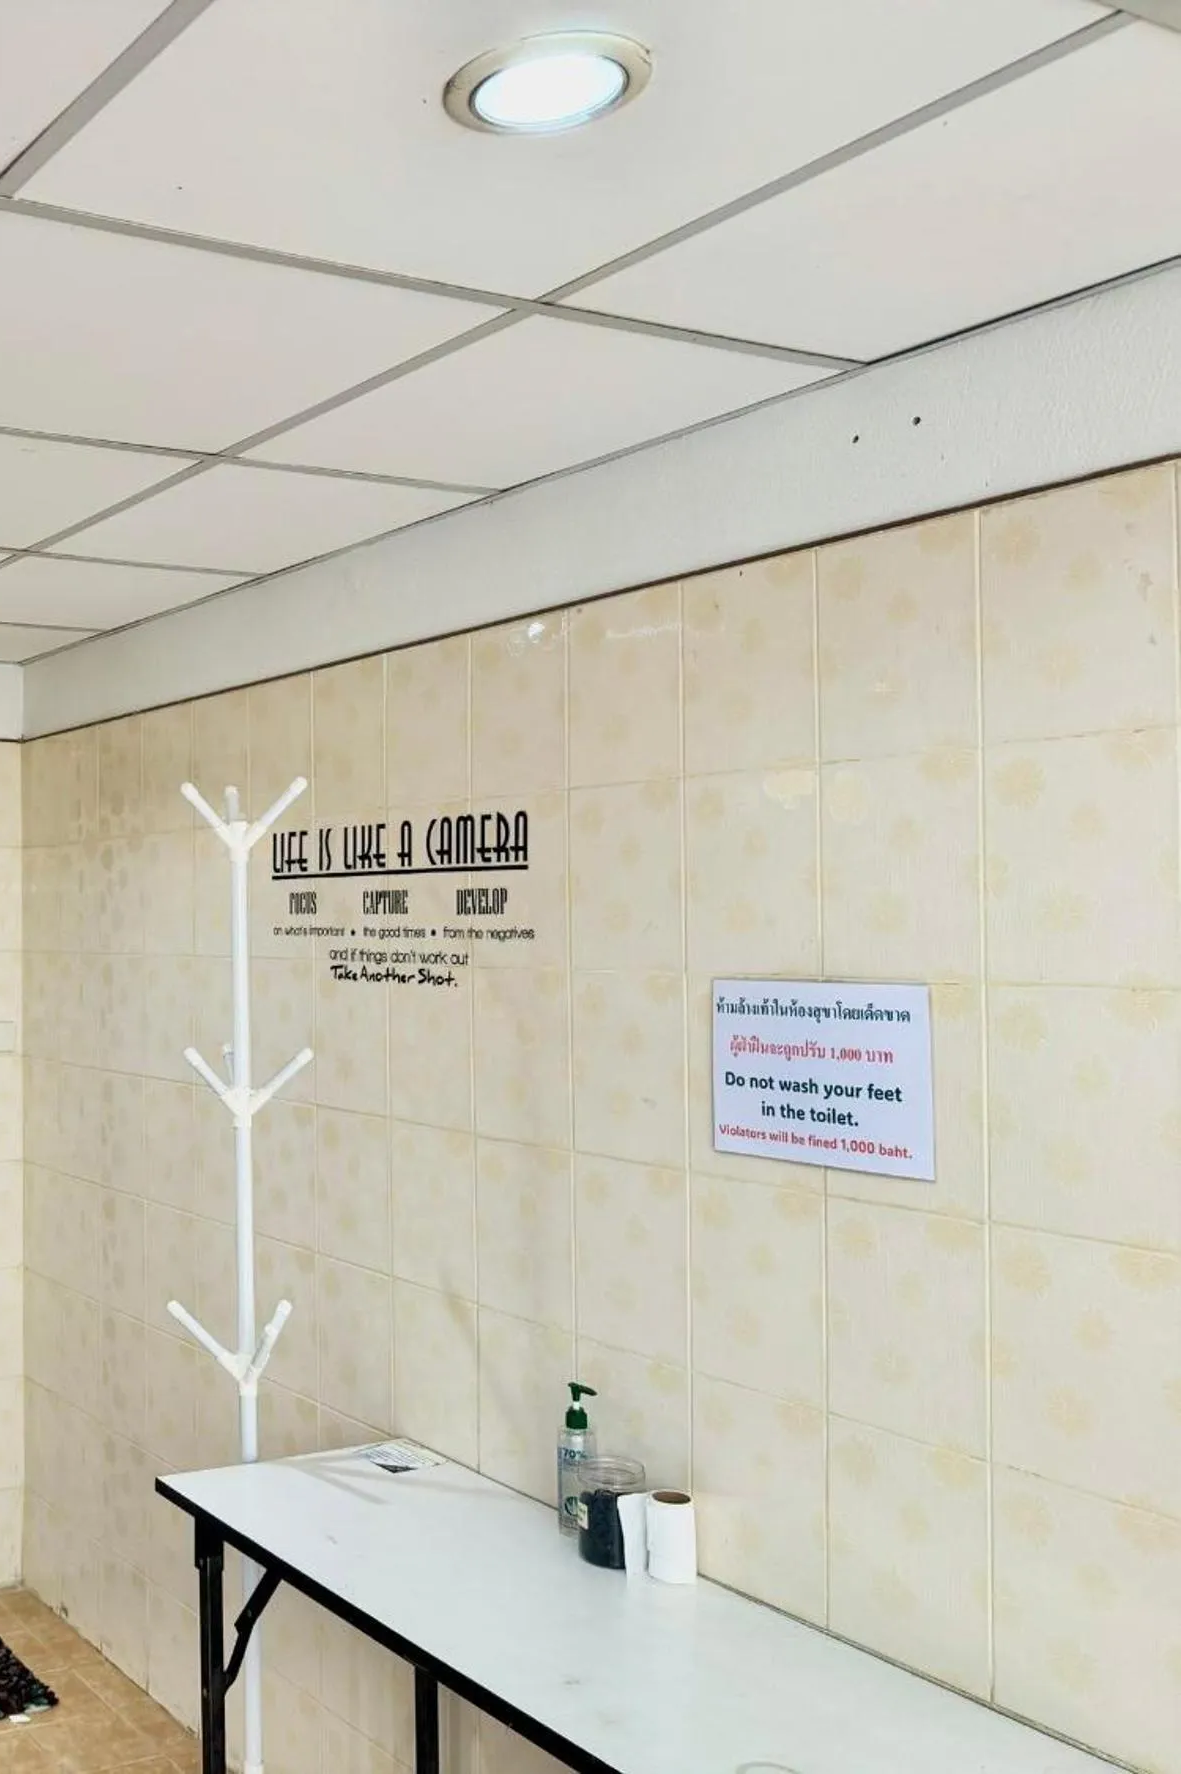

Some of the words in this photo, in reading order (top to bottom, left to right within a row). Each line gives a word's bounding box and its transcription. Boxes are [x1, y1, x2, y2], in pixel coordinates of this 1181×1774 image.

[273, 831, 308, 873] LIFE
[319, 828, 332, 871] IS
[344, 824, 386, 870] LIKE
[397, 820, 412, 867] A
[426, 811, 528, 865] CAMERA
[289, 890, 317, 915] FOCUS
[363, 889, 408, 915] CAPTURE
[456, 888, 508, 915] DEVELOP
[363, 927, 377, 937] the
[378, 927, 400, 941] good
[402, 927, 426, 938] times
[443, 927, 465, 939] from
[467, 927, 483, 940] the
[486, 928, 535, 941] negatives
[330, 949, 348, 961] and
[350, 949, 358, 961] if
[359, 950, 388, 965] things
[391, 950, 416, 963] don't
[419, 951, 448, 964] work
[451, 953, 470, 966] out
[330, 965, 358, 981] Take
[360, 966, 415, 984] Another
[418, 968, 458, 987] Shot.
[830, 1048, 862, 1062] 1,000
[867, 1050, 893, 1064] บาท
[725, 1071, 745, 1086] Do
[750, 1076, 774, 1090] not
[779, 1078, 818, 1094] wash
[823, 1084, 862, 1100] your
[867, 1084, 902, 1102] feet
[761, 1101, 775, 1117] in
[780, 1104, 805, 1120] the
[810, 1108, 859, 1127] toilet.
[719, 1125, 766, 1140] Violators
[769, 1129, 788, 1143] will
[791, 1132, 805, 1145] be
[808, 1135, 837, 1149] fined
[841, 1139, 875, 1154] 1,000
[879, 1143, 913, 1159] baht.
